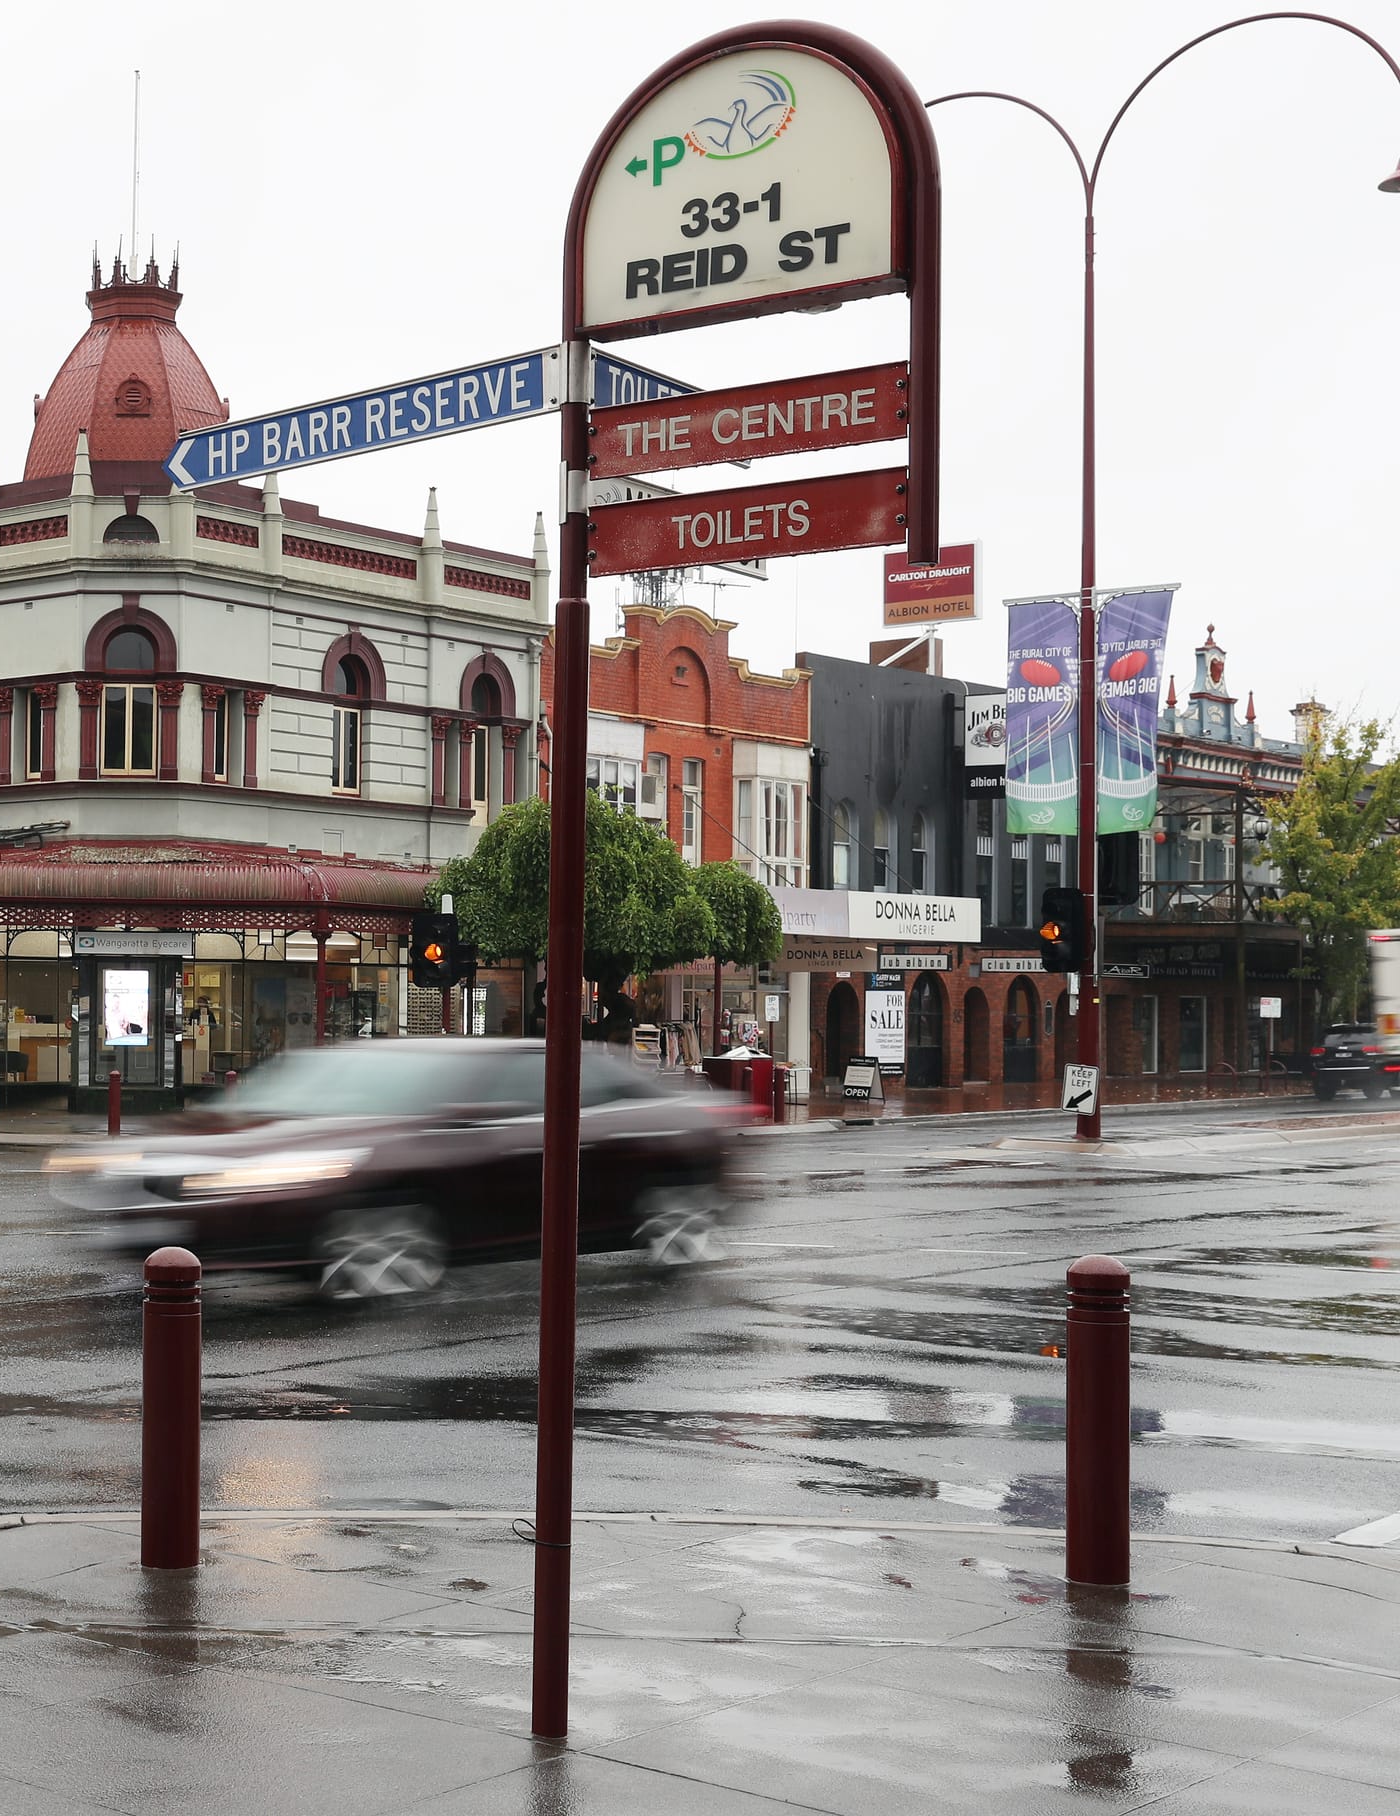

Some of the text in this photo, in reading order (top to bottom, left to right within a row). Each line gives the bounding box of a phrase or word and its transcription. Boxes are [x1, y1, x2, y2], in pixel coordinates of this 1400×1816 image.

[653, 136, 686, 186] P
[681, 182, 782, 238] 33-1
[625, 223, 851, 299] REID ST
[208, 361, 532, 477] HP BARR RESERVE
[618, 387, 877, 456] THE CENTRE
[671, 499, 810, 550] TOILETS
[888, 565, 971, 583] CARLTON DRAUGHT
[888, 601, 971, 617] ALBION HOTEL
[1009, 647, 1073, 660] THE RURAL CITY OF
[1007, 686, 1072, 704] BIG GAMES
[968, 710, 989, 731] JIM
[970, 776, 997, 787] albion
[875, 900, 956, 922] DONNA BELLA
[898, 924, 935, 936] LINGERIE
[96, 938, 188, 950] Wangaratta Eyecare
[787, 949, 863, 960] DONNA BELLA
[906, 957, 942, 968] albion
[987, 960, 1010, 970] club
[886, 995, 903, 1007] FOR
[870, 1010, 903, 1029] SALE
[1071, 1069, 1093, 1080] KEEP
[1071, 1078, 1091, 1089] LEFT
[845, 1088, 869, 1097] OPEN
